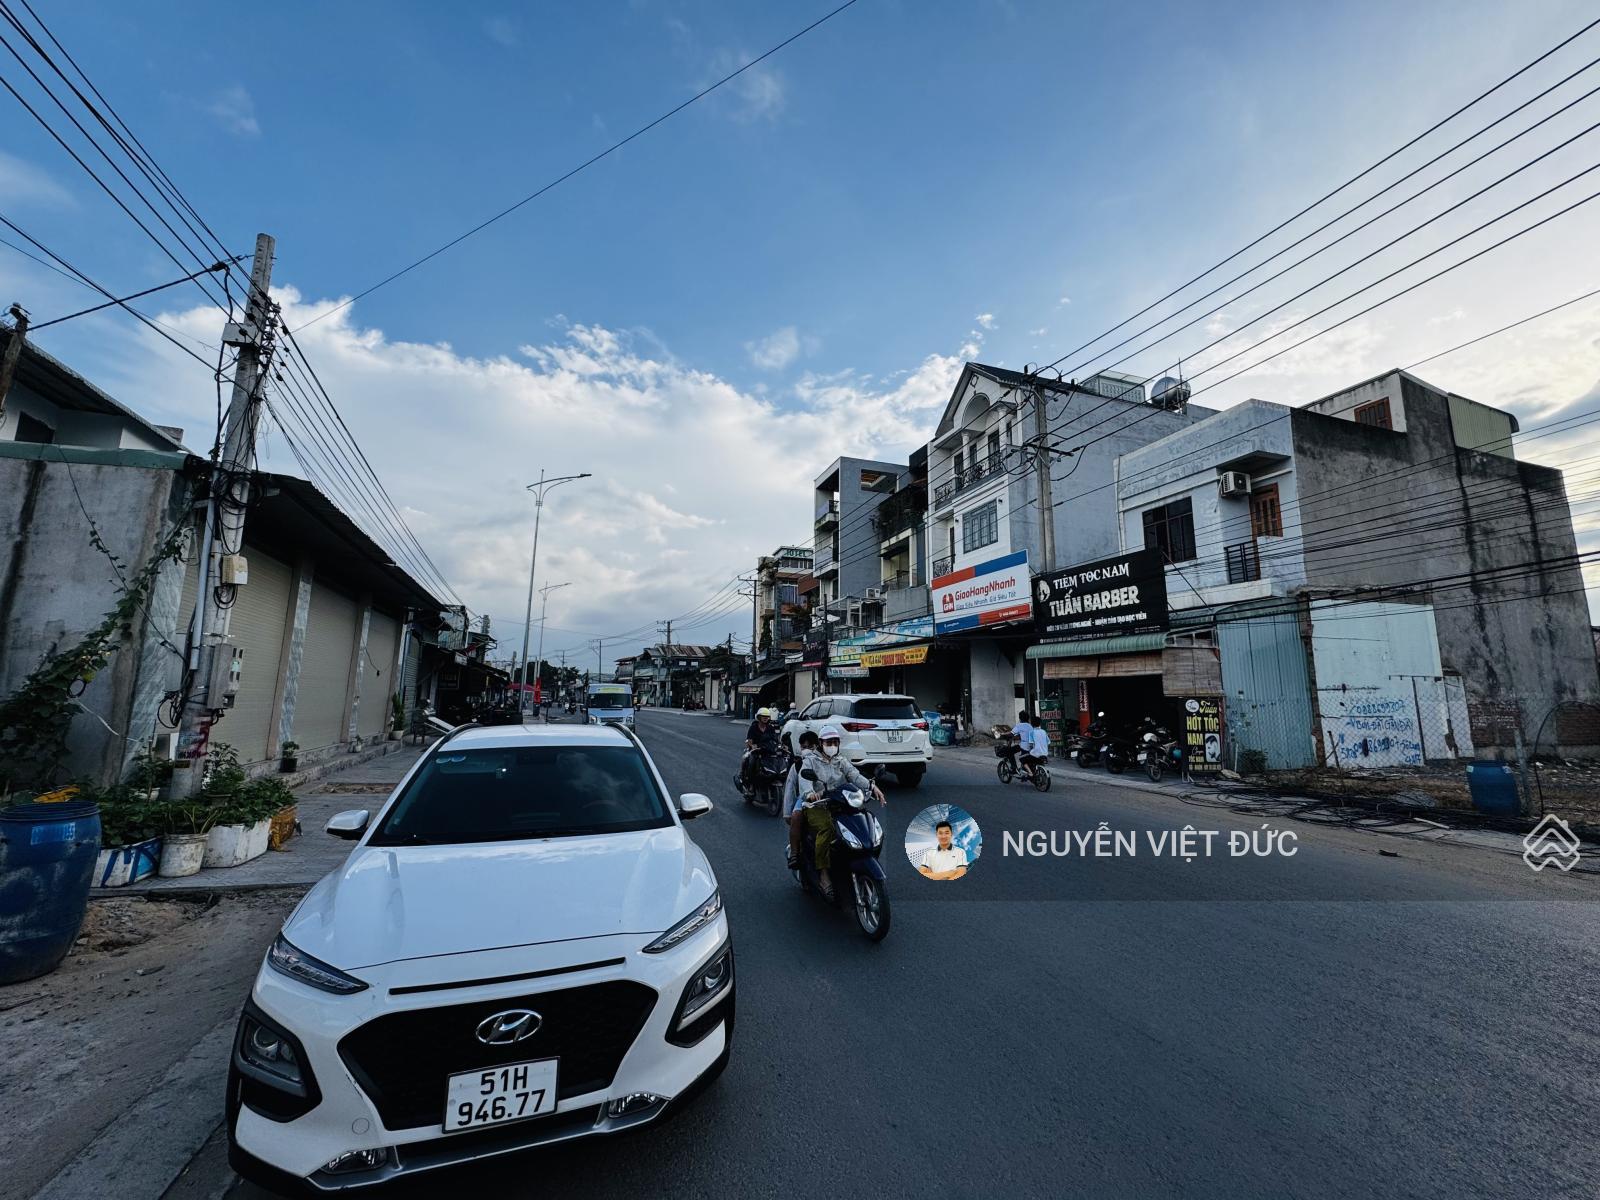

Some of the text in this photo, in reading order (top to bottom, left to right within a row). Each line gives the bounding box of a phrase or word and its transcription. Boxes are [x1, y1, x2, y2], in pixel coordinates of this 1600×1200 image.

[1102, 563, 1130, 579] NAM
[1049, 586, 1140, 617] TUẤN BARBER
[1187, 732, 1204, 746] NAM
[480, 1066, 528, 1096] 51H
[458, 1088, 546, 1127] 946.77
